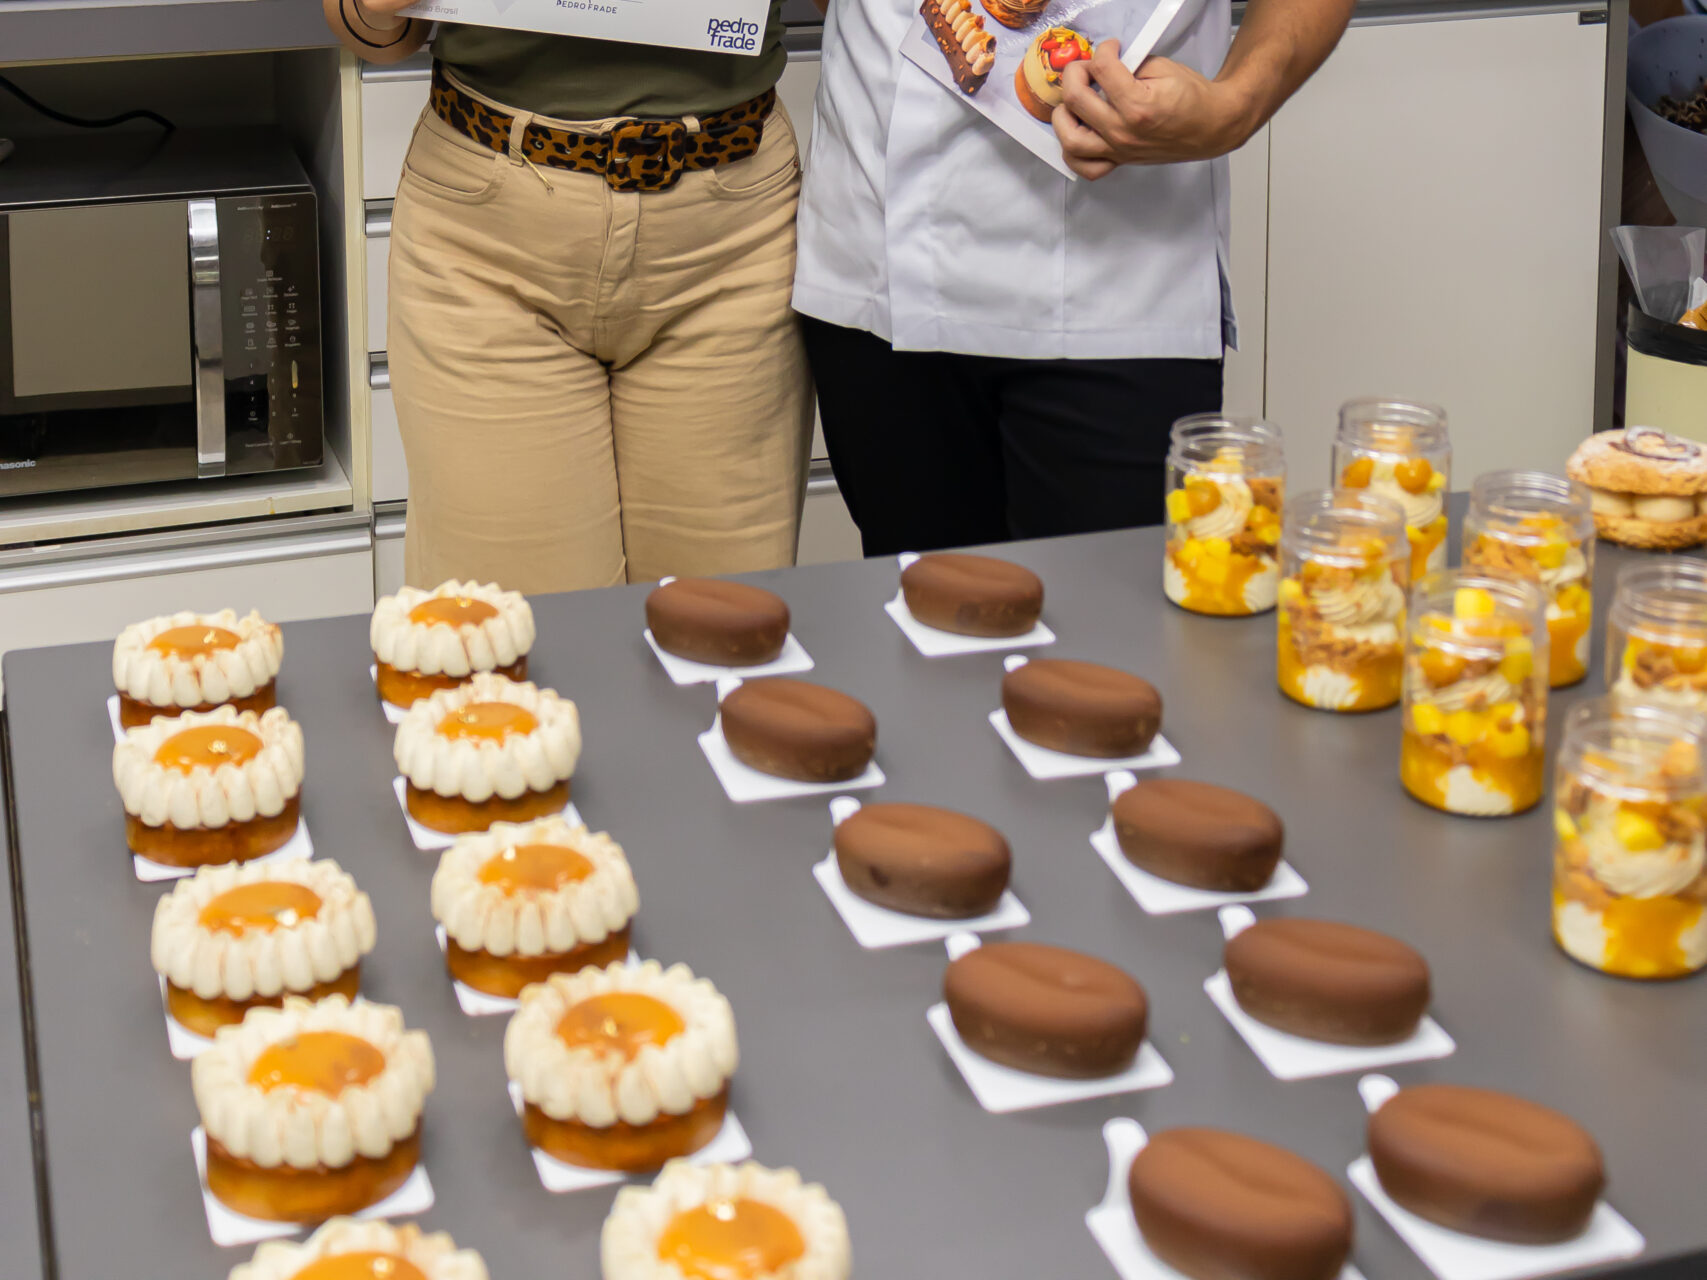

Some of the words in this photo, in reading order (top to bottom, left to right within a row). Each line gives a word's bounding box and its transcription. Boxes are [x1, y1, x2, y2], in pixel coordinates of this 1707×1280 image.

[556, 0, 586, 10] PEDRO
[587, 3, 617, 14] FRADE
[707, 17, 759, 35] pedro
[710, 30, 756, 51] frade
